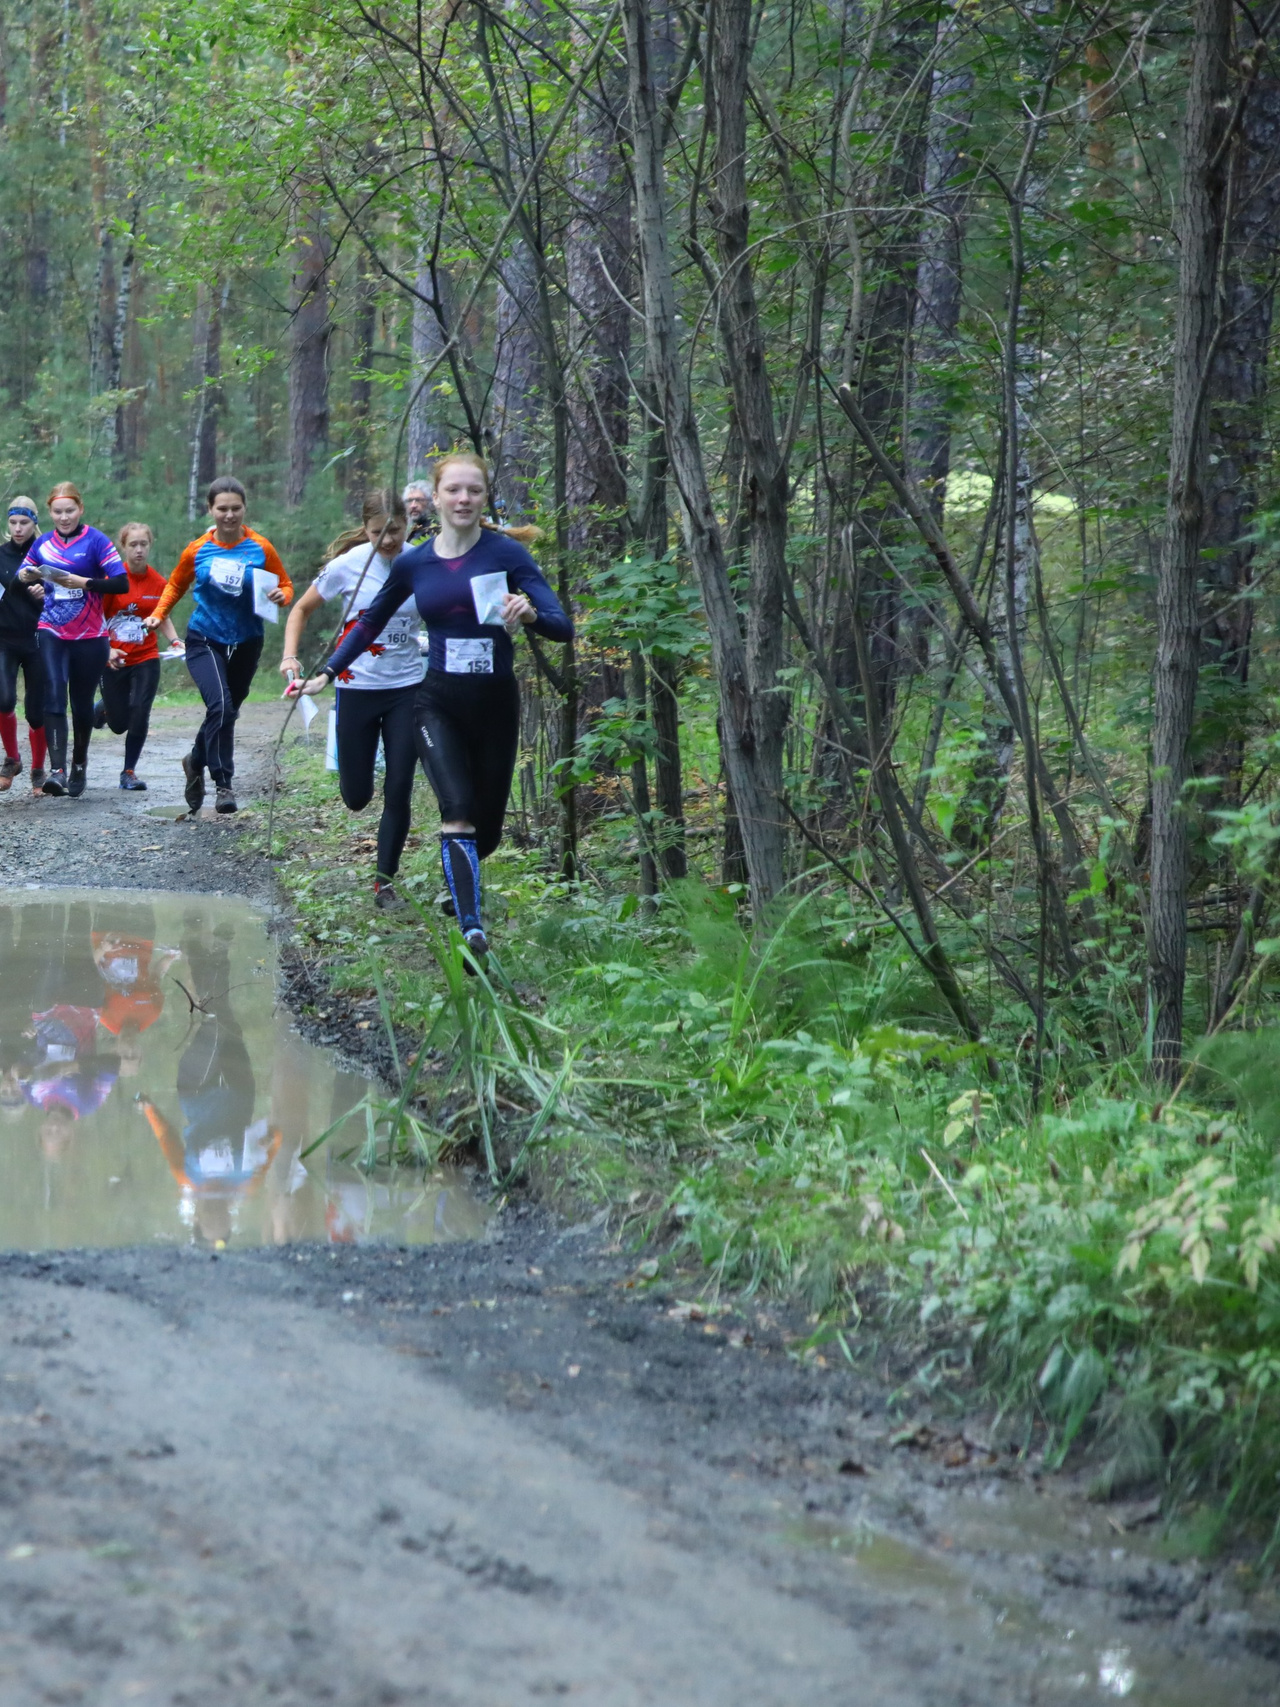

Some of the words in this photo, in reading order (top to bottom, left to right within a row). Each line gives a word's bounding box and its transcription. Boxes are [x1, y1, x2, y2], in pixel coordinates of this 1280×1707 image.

[225, 575, 240, 585] 157
[67, 589, 82, 598] 155
[388, 633, 407, 643] 160
[468, 660, 491, 673] 152
